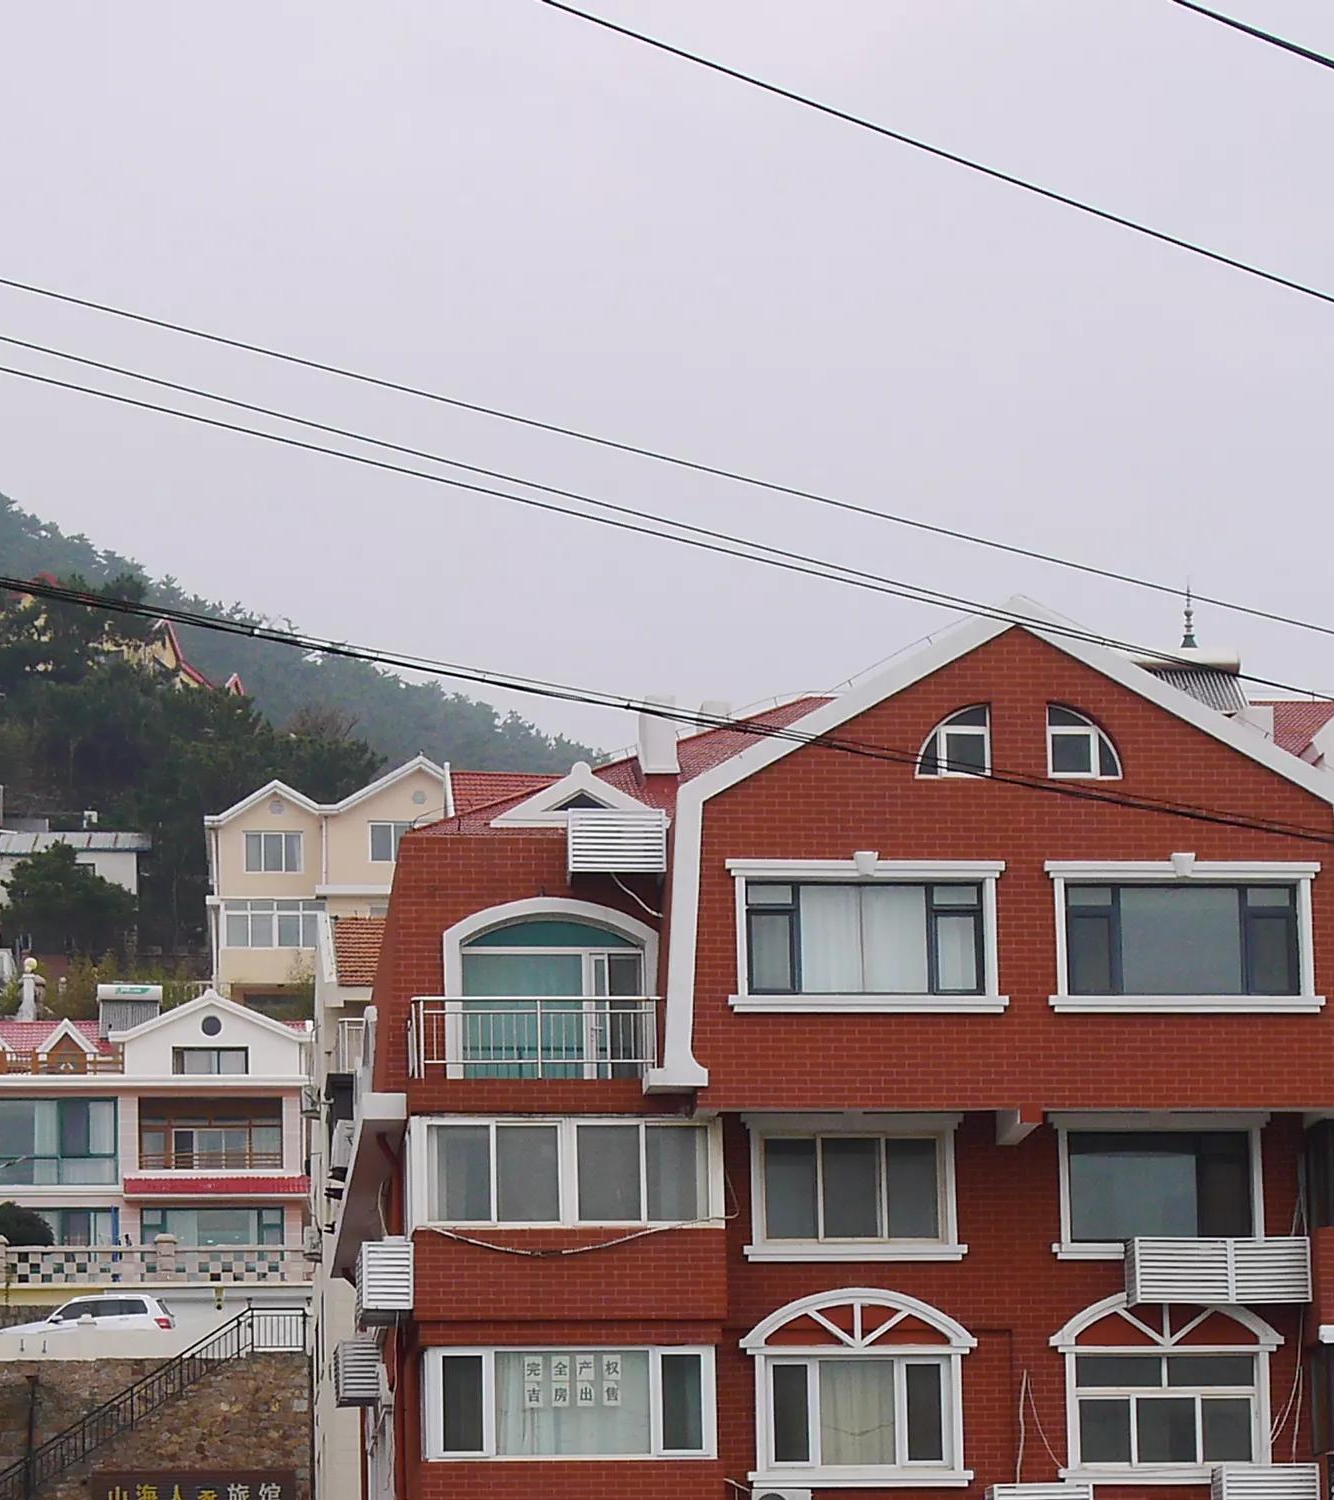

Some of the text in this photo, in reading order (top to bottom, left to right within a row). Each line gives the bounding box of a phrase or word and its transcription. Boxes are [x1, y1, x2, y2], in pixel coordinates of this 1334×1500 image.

[526, 1360, 620, 1378] 完全产权
[526, 1386, 620, 1403] 吉房出售
